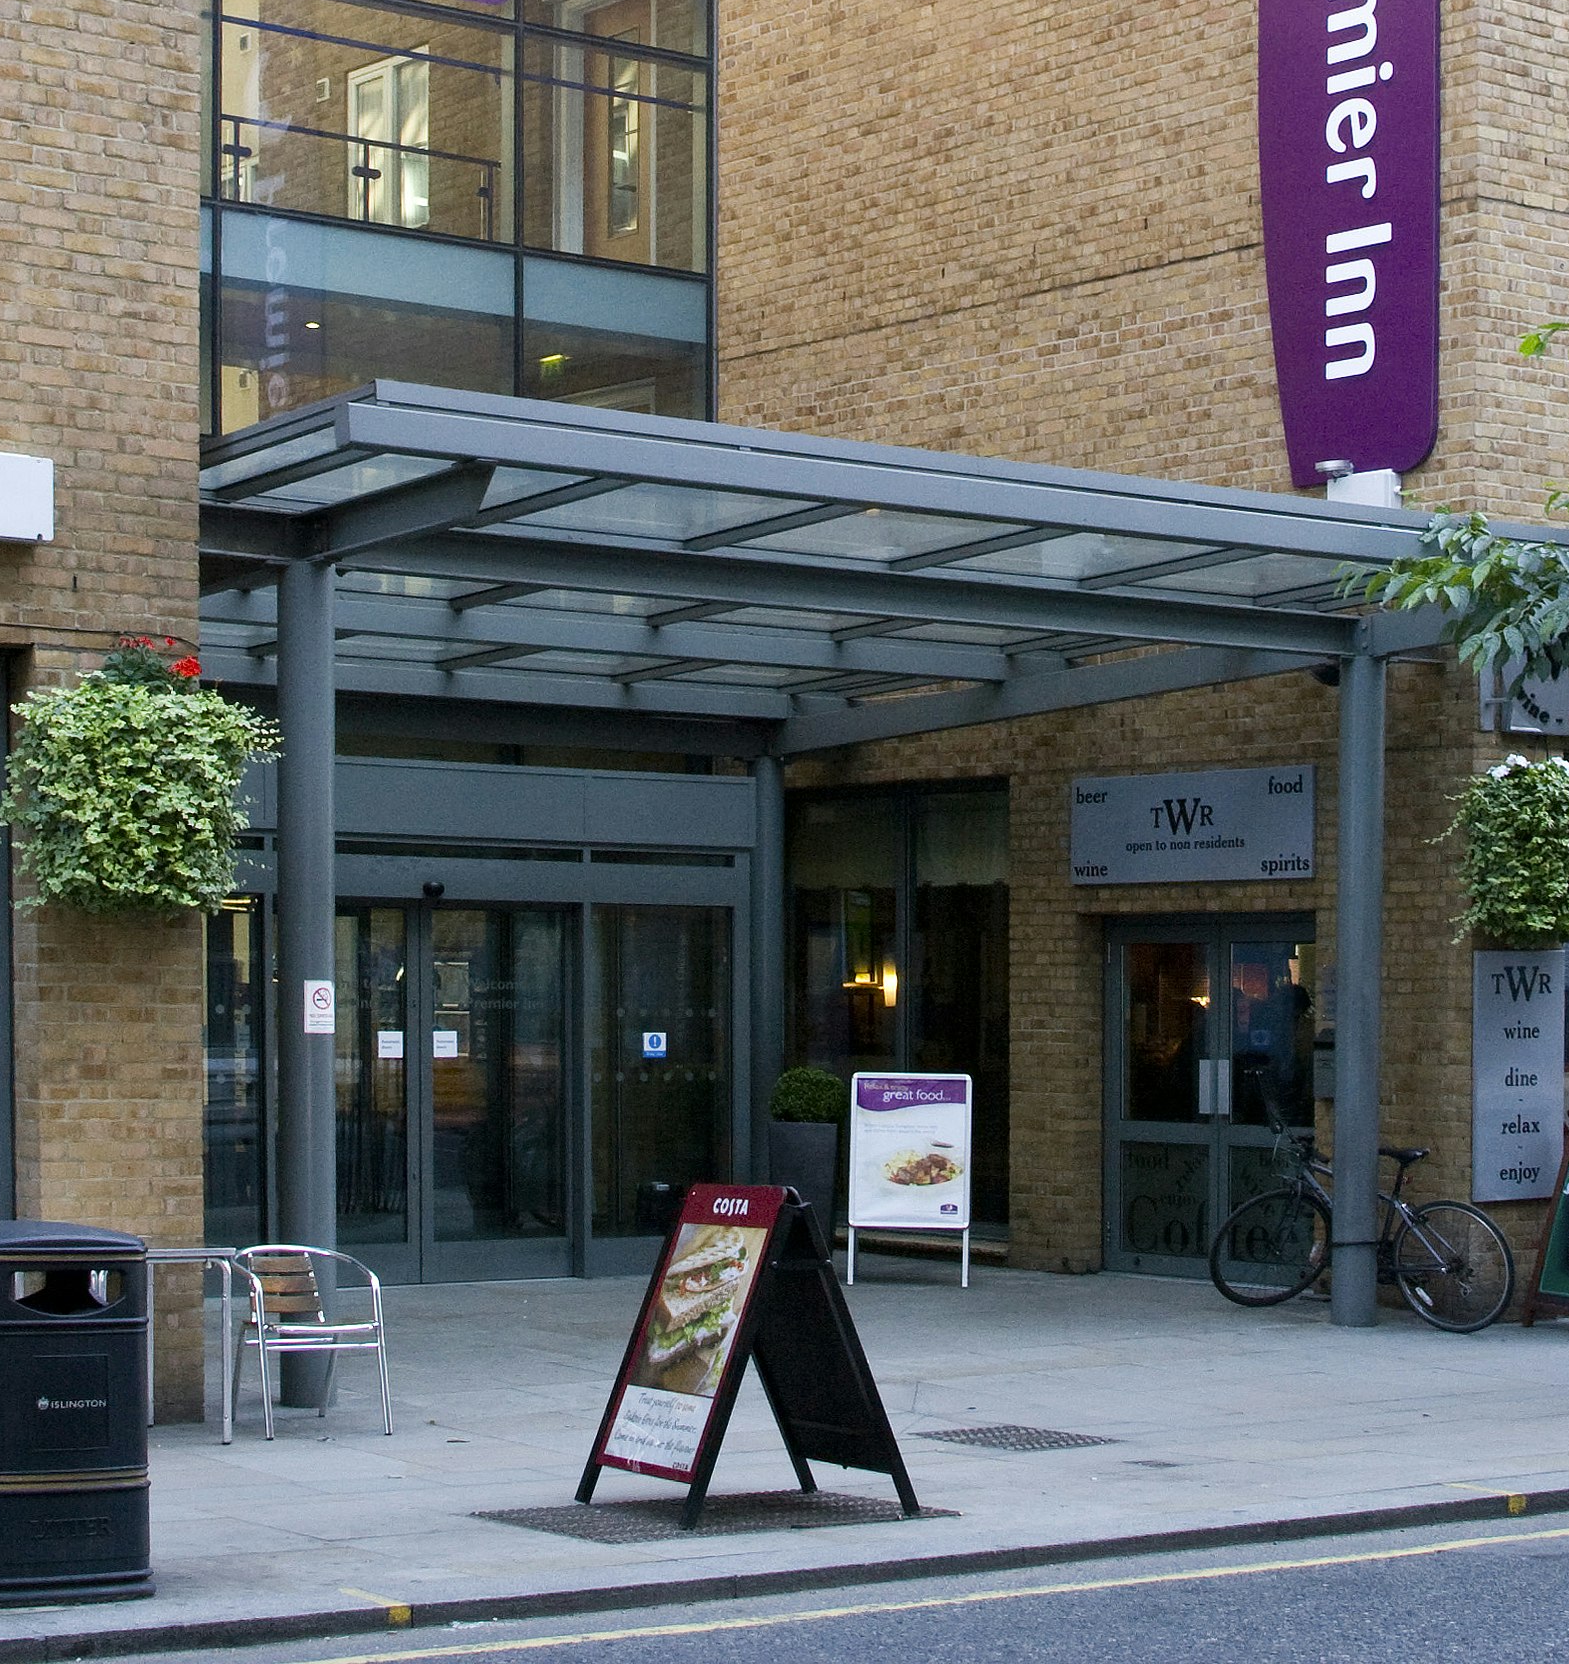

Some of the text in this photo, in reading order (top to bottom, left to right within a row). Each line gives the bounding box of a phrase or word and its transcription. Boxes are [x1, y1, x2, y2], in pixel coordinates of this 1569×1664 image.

[1324, 221, 1392, 381] Inn
[1267, 774, 1304, 795] food
[1076, 787, 1108, 804] beer
[1150, 798, 1215, 835] TWR
[1125, 835, 1246, 855] open to non residents
[1074, 860, 1108, 877] wine
[1260, 853, 1310, 875] spirits
[1491, 965, 1552, 1003] TWR
[1504, 1020, 1540, 1039] wine
[1504, 1067, 1538, 1087] dine
[883, 1090, 913, 1103] great
[1501, 1114, 1541, 1135] relax
[1499, 1161, 1541, 1184] enjoy
[713, 1197, 749, 1216] COSTA
